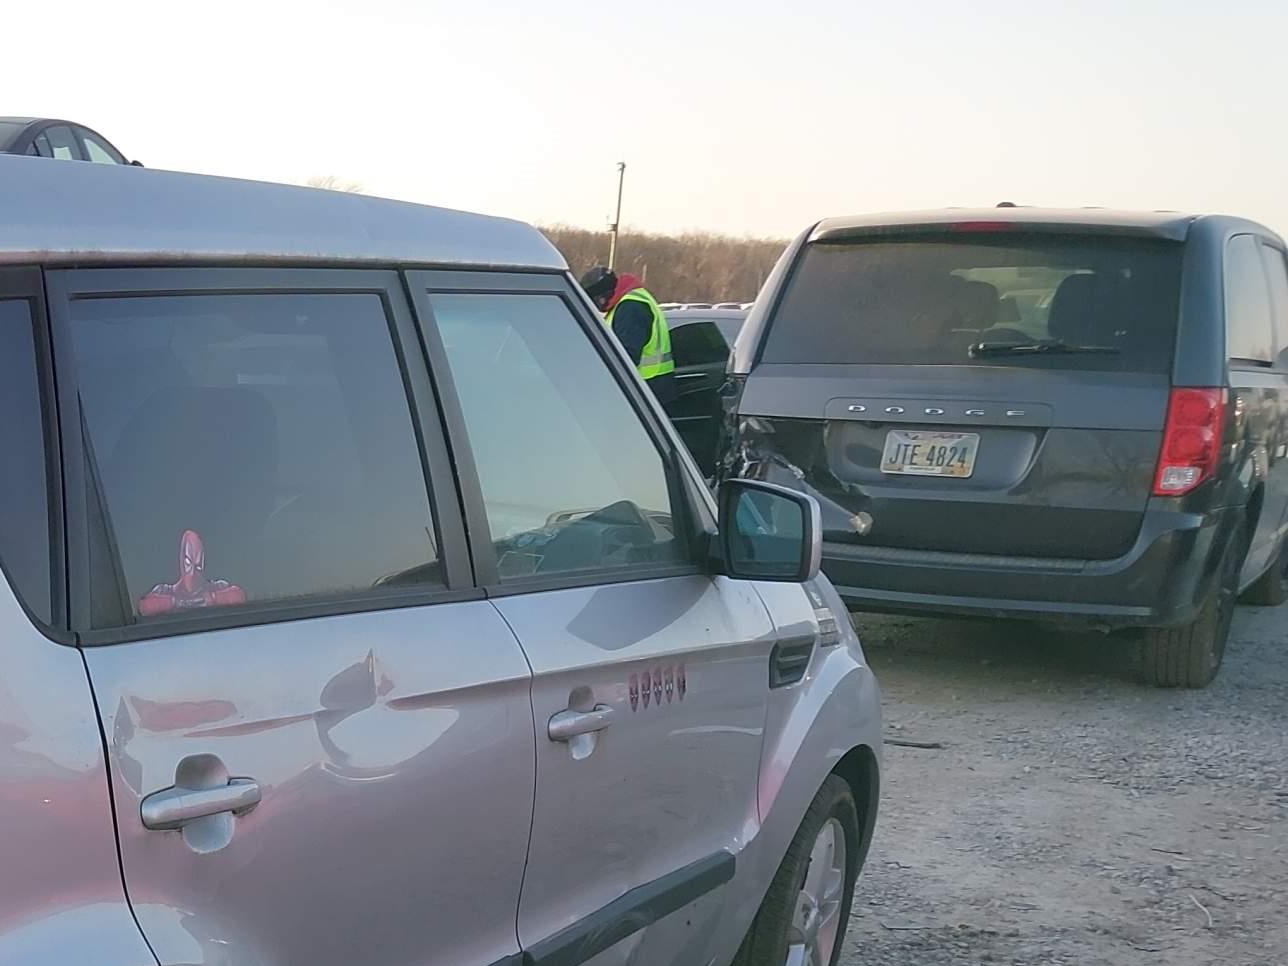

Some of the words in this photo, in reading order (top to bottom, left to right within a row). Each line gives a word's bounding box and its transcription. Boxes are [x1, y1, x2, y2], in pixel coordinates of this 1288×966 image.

[848, 404, 1025, 417] DODGE
[889, 443, 921, 466] JTE
[926, 445, 969, 468] 4824
